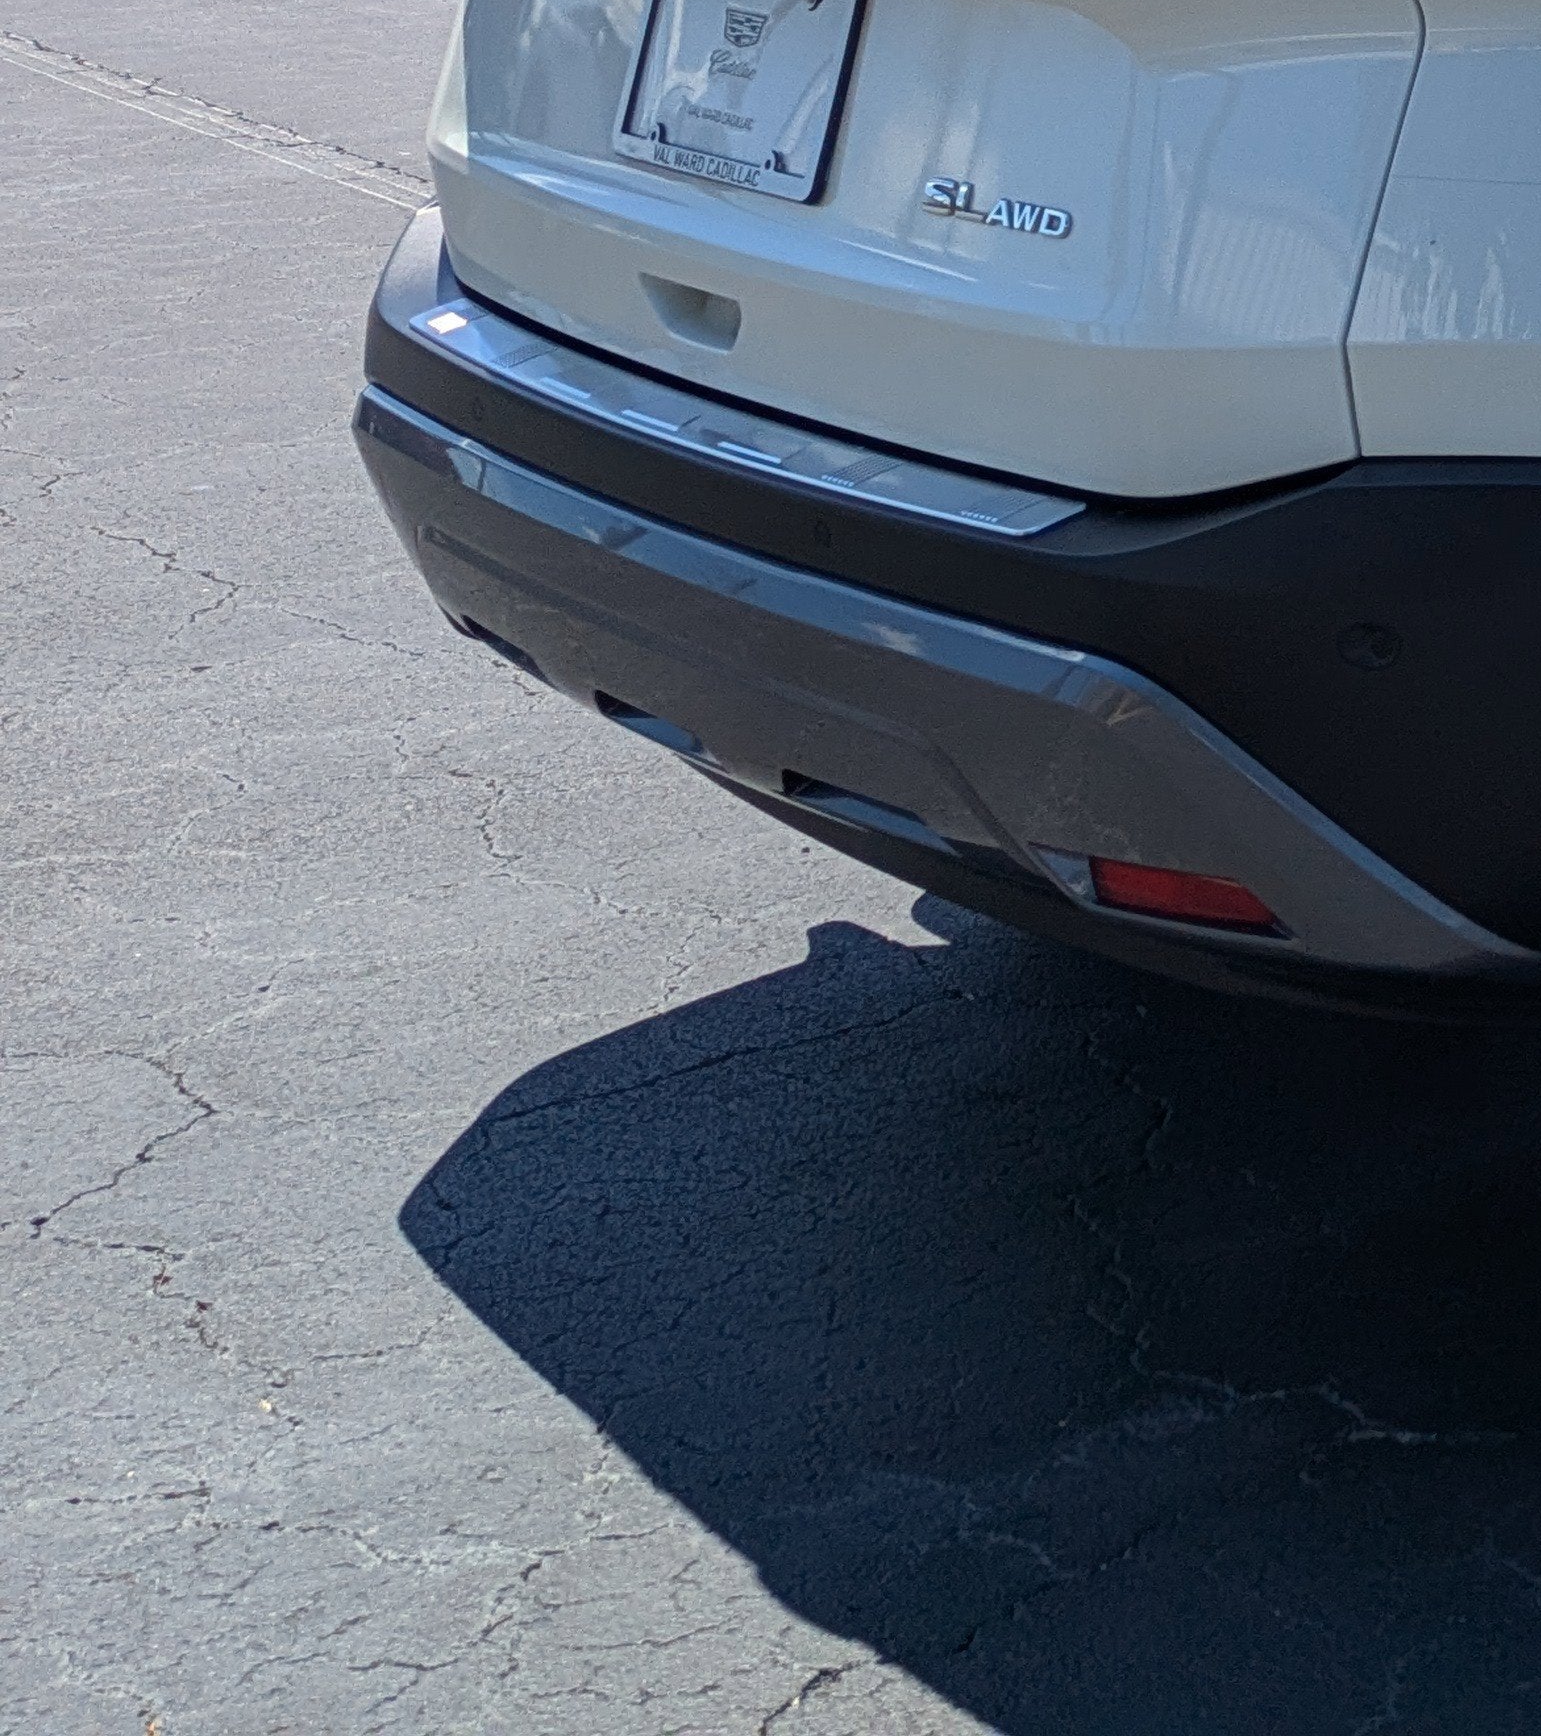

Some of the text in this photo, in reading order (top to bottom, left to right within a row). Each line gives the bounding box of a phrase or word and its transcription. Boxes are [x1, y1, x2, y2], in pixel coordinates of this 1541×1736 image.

[653, 144, 760, 187] VAL WARD CADILLAC
[922, 175, 1073, 239] SL AWD
